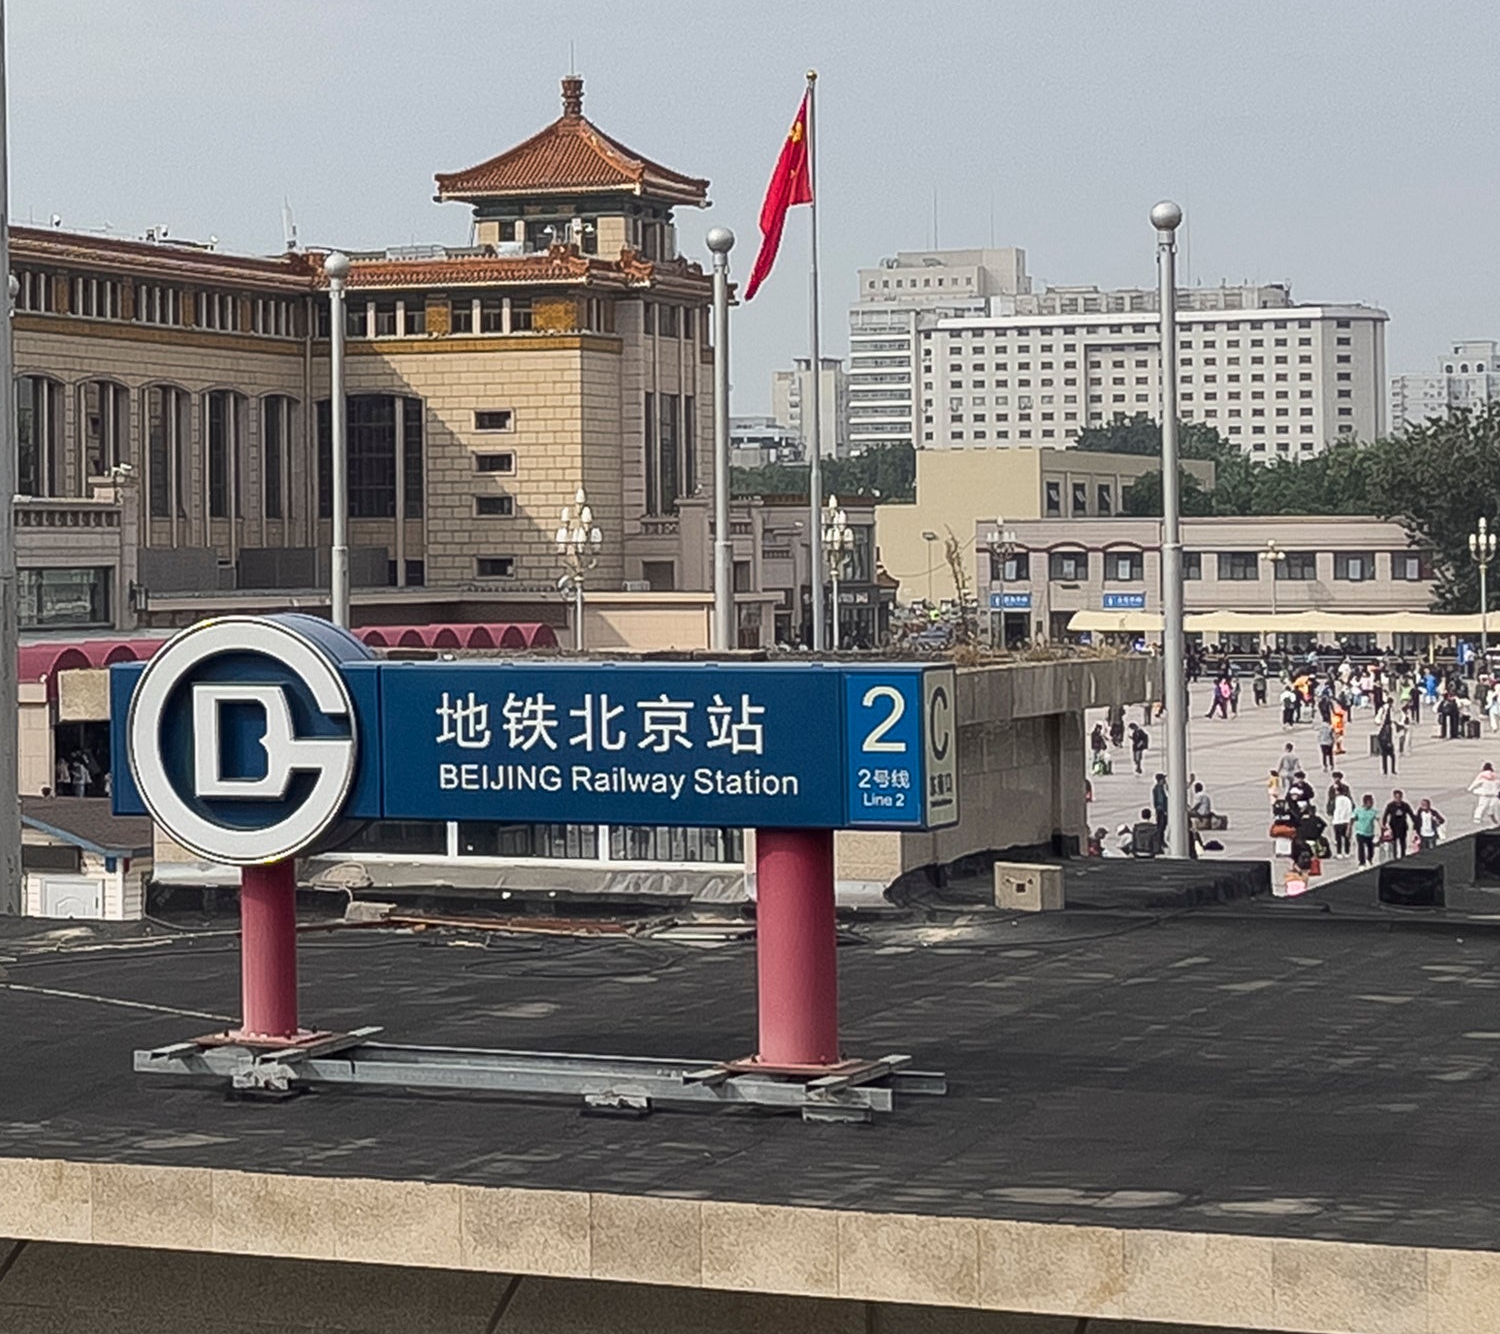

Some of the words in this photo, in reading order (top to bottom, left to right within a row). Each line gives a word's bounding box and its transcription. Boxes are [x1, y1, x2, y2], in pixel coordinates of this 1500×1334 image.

[435, 692, 765, 754] 地铁北京站
[862, 686, 906, 752] 2
[930, 686, 949, 761] C
[439, 764, 562, 791] BEIJING
[572, 766, 686, 800] Railway
[694, 767, 799, 795] Station
[858, 768, 910, 789] 2号线
[864, 793, 893, 807] Line
[895, 793, 905, 807] 2
